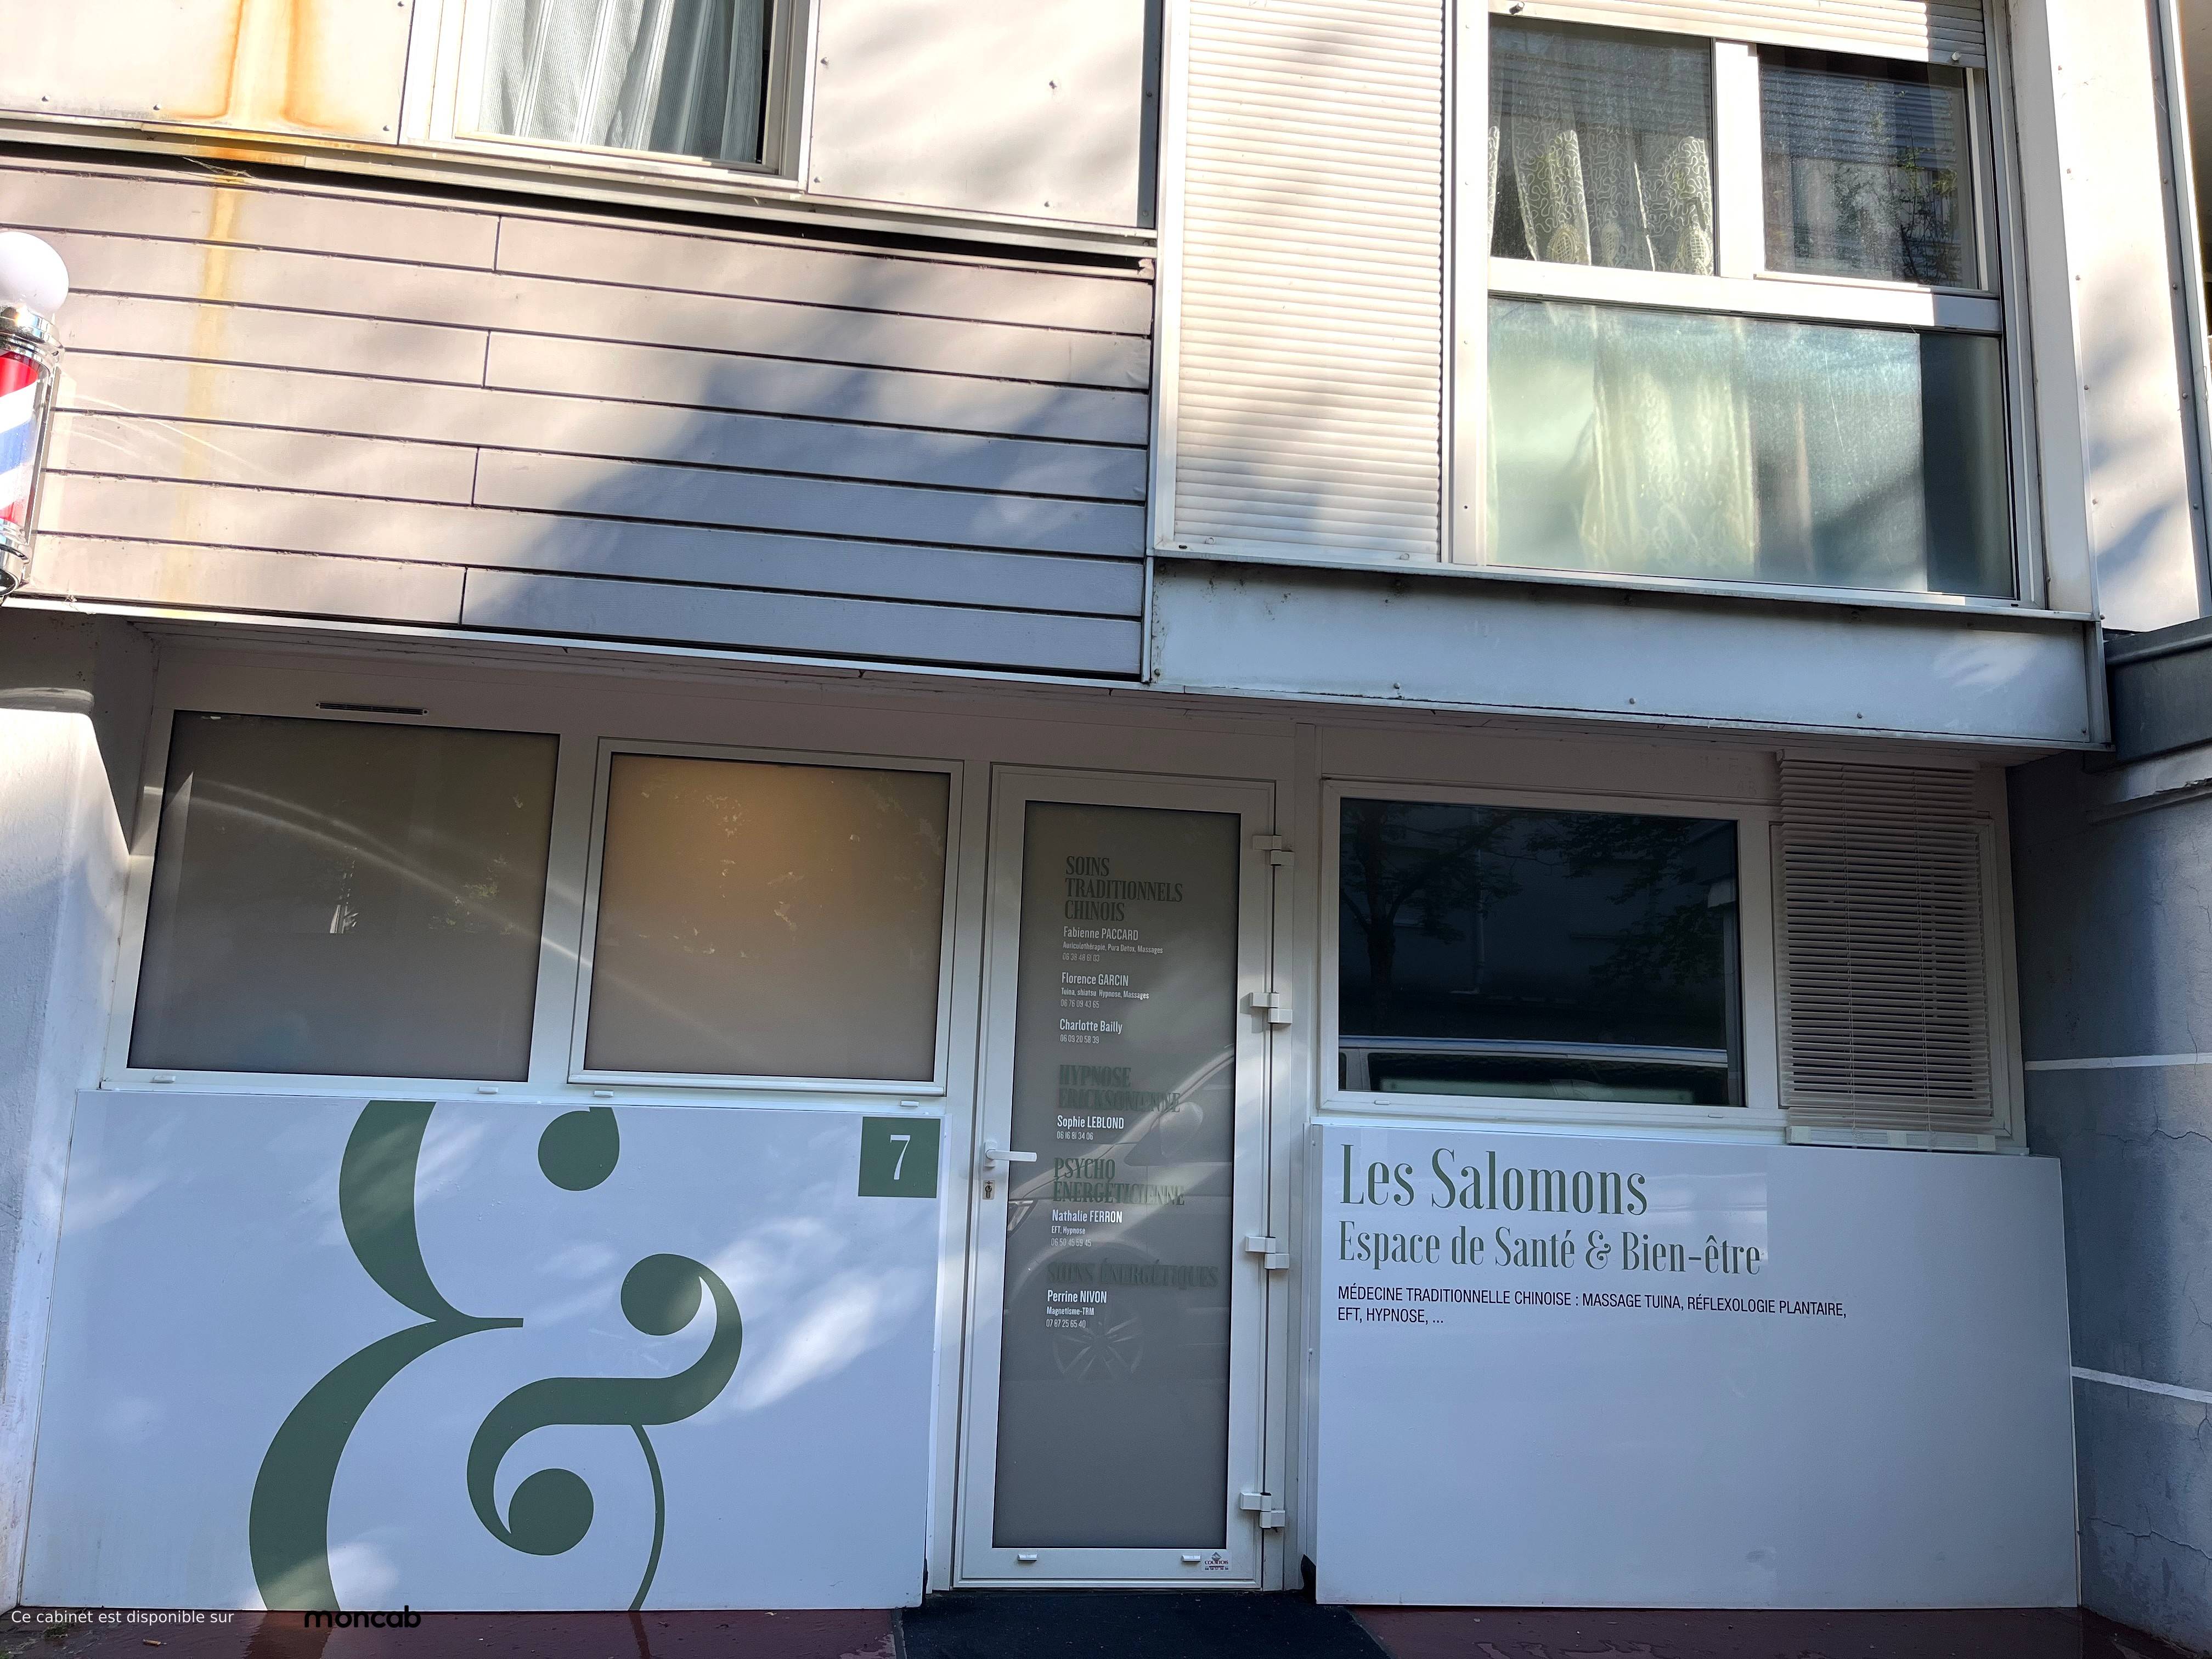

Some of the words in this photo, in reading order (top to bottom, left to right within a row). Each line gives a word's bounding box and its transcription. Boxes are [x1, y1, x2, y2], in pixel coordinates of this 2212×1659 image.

[1066, 856, 1110, 876] SOINS
[1065, 878, 1183, 902] TRADITIONNELS
[1065, 900, 1125, 921] CHINOIS
[1064, 926, 1099, 939] Fabienne
[1101, 928, 1138, 941] PACCARD
[1108, 944, 1120, 952] Pura
[1137, 945, 1163, 955] Massages
[1062, 972, 1096, 985] Florence
[1098, 974, 1128, 986] GARCIN
[1061, 988, 1076, 996] Tuina,
[1099, 990, 1122, 999] Hypnose,
[1123, 991, 1149, 1001] Massages
[1060, 1018, 1098, 1032] Charlotte
[1100, 1020, 1122, 1035] Bailly
[1059, 1064, 1131, 1087] HYPNOSE
[1057, 1115, 1085, 1129] Sophie
[1087, 1116, 1124, 1129] LEBLOND
[1071, 1131, 1077, 1139] 81
[1086, 1132, 1093, 1140] 06
[890, 1134, 911, 1181] 7
[1054, 1158, 1115, 1180] PSYCHO
[1340, 1144, 1414, 1206] Les
[1431, 1148, 1647, 1216] Salomons
[1052, 1209, 1087, 1222] Nathalie
[1090, 1210, 1122, 1223] FERRON
[1051, 1225, 1062, 1234] EFT,
[1063, 1226, 1086, 1235] Hypnose
[1051, 1238, 1058, 1246] 06
[1085, 1239, 1092, 1247] 45
[1339, 1221, 1440, 1270] Espace
[1452, 1226, 1484, 1265] de
[1495, 1226, 1575, 1268] Santé
[1585, 1230, 1611, 1269] &
[1621, 1231, 1760, 1274] Bien-être
[1047, 1262, 1094, 1283] SOINS
[1047, 1290, 1078, 1302] Perrine
[1080, 1291, 1107, 1304] NIVON
[1338, 1283, 1403, 1301] MÉDECINE
[1406, 1288, 1510, 1304] TRADITIONNELLE
[1514, 1291, 1571, 1306] CHINOISE
[1583, 1293, 1641, 1308] MASSAGE
[1645, 1295, 1684, 1311] TUINA,
[1688, 1294, 1775, 1313] RÉFLEXOLOGIE
[1779, 1301, 1847, 1318] PLANTAIRE,
[1046, 1319, 1053, 1327] 07
[1054, 1319, 1061, 1327] 87
[1062, 1319, 1069, 1328] 25
[1070, 1319, 1077, 1328] 65
[1079, 1320, 1086, 1328] 40
[1338, 1307, 1362, 1323] EFT,
[1367, 1308, 1428, 1325] HYPNOSE,
